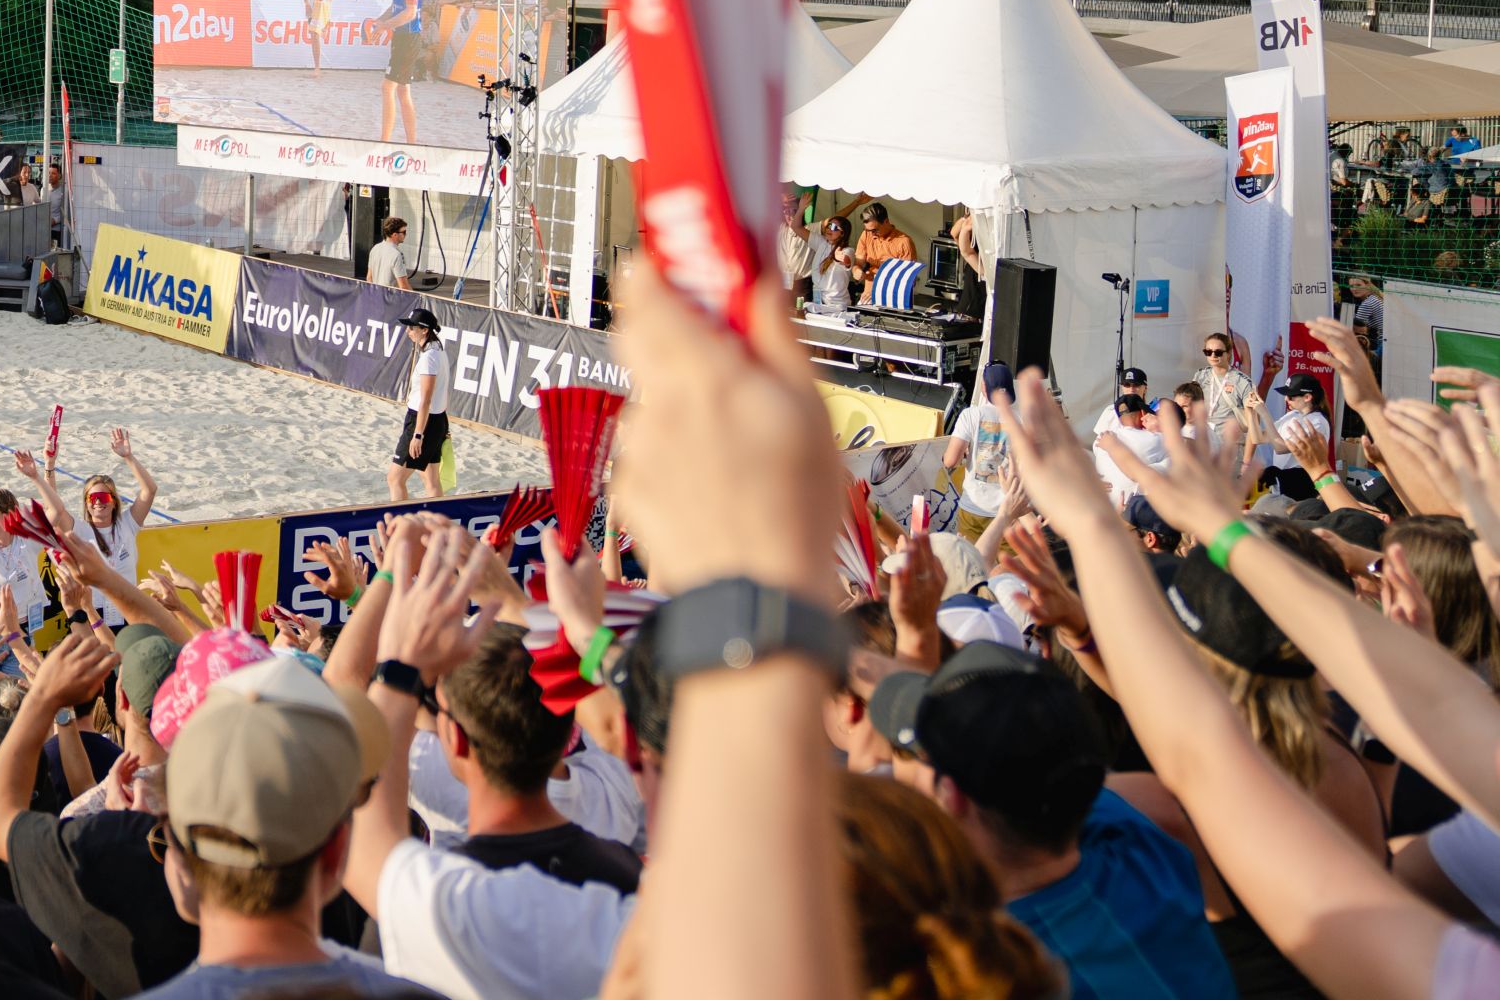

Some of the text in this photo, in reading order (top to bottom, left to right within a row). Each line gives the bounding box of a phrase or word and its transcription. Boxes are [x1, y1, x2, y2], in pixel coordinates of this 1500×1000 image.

[194, 137, 249, 157] METROPOL
[278, 145, 336, 165] METROPOL
[366, 153, 427, 173] METROPOL
[103, 254, 213, 322] MIKASA
[1146, 288, 1160, 303] VIP
[106, 299, 132, 315] GERMANY
[131, 306, 143, 319] AND
[143, 310, 168, 326] AUSTRIA
[243, 290, 402, 358] EuroVolley.TV
[578, 356, 633, 390] BANK
